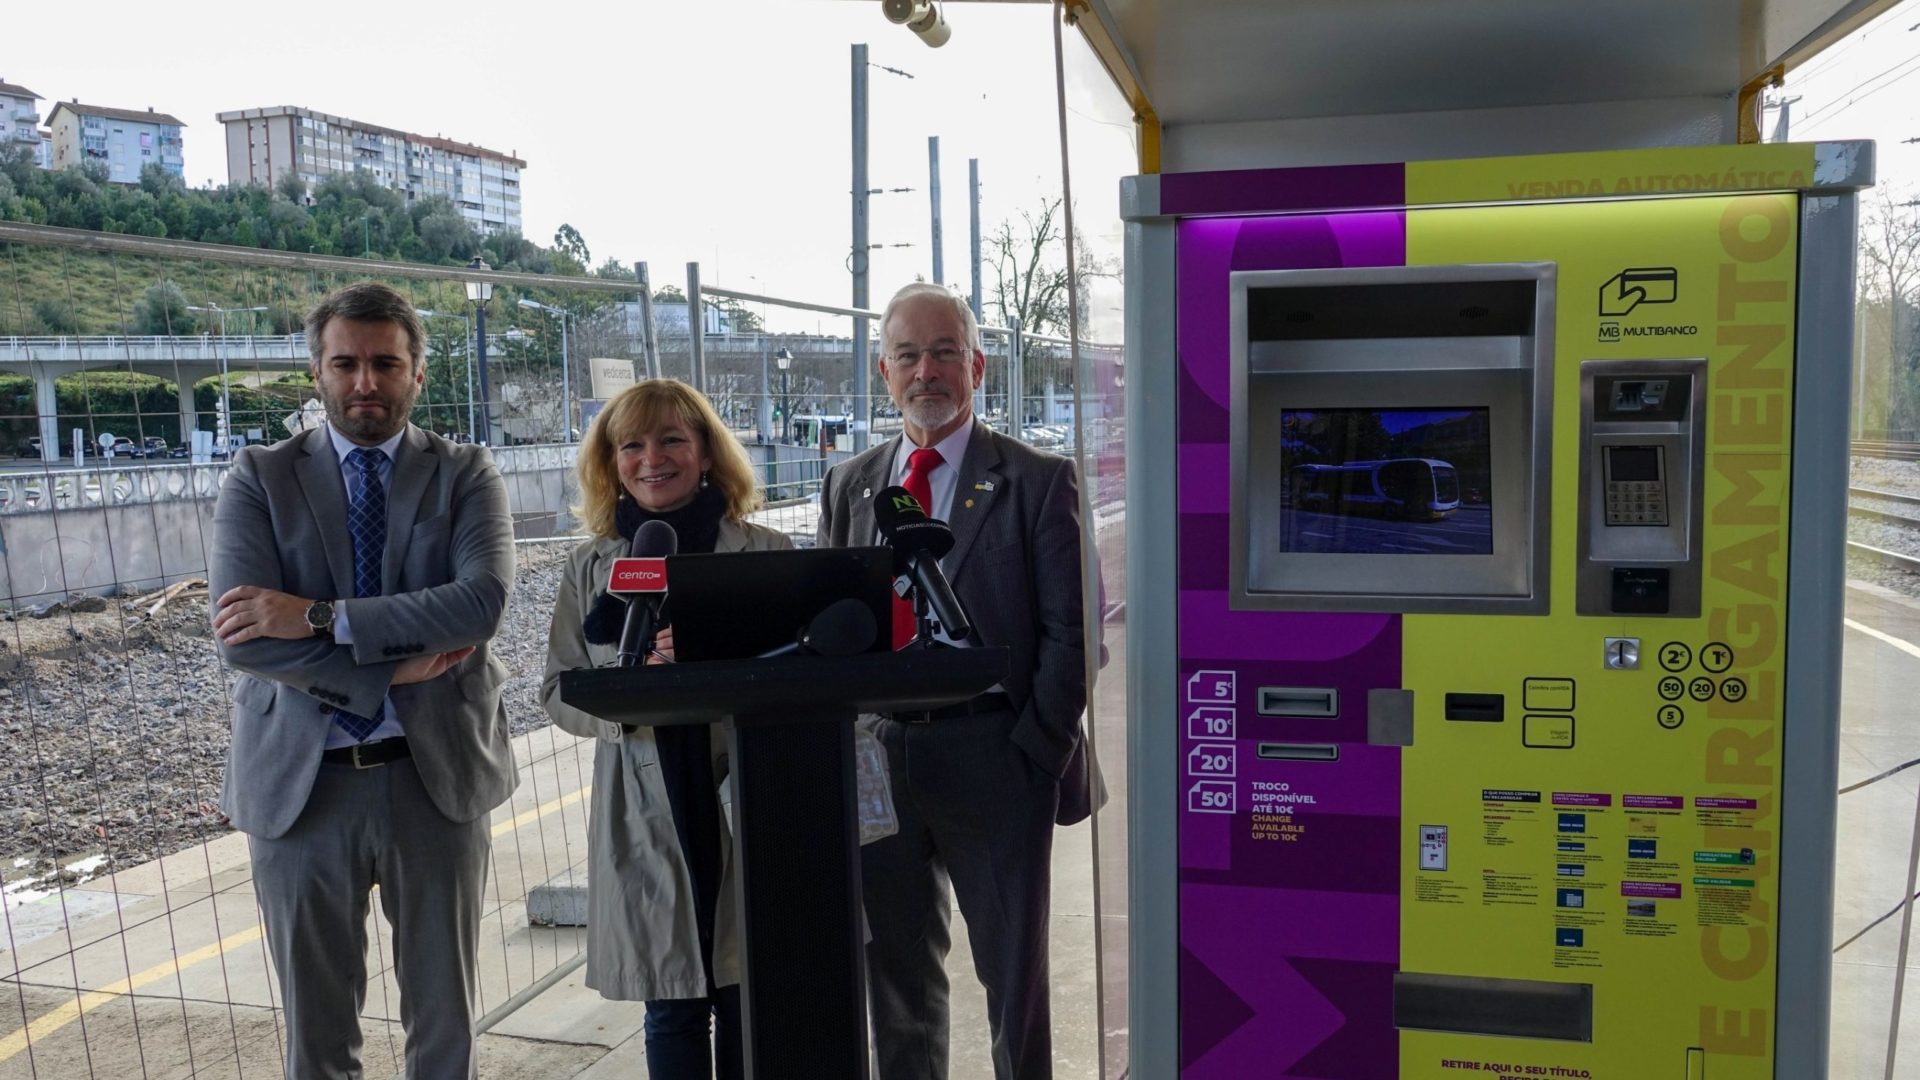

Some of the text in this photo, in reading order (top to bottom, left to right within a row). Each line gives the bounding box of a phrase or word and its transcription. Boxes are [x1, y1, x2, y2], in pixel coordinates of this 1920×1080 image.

[1506, 166, 1807, 199] VENDA AUTOMÁTICA
[1599, 325, 1698, 339] MB MULTIBANCO
[618, 570, 654, 581] centro
[1667, 649, 1685, 665] 2€
[1712, 650, 1727, 665] 1€
[1663, 682, 1680, 692] 50
[1694, 683, 1710, 693] 20
[1726, 684, 1740, 693] 10
[1666, 711, 1675, 720] 5
[1252, 782, 1290, 791] TROCO
[1252, 792, 1317, 804] DISPONÍVEL
[1252, 803, 1294, 814] ATÉ 10€
[1252, 814, 1292, 824] CHANGE
[1252, 823, 1305, 833] AVAILABLE
[1252, 832, 1297, 842] UP TO 10€
[1441, 1059, 1592, 1079] RETIRE AQUI O SEU TÍTULO,
